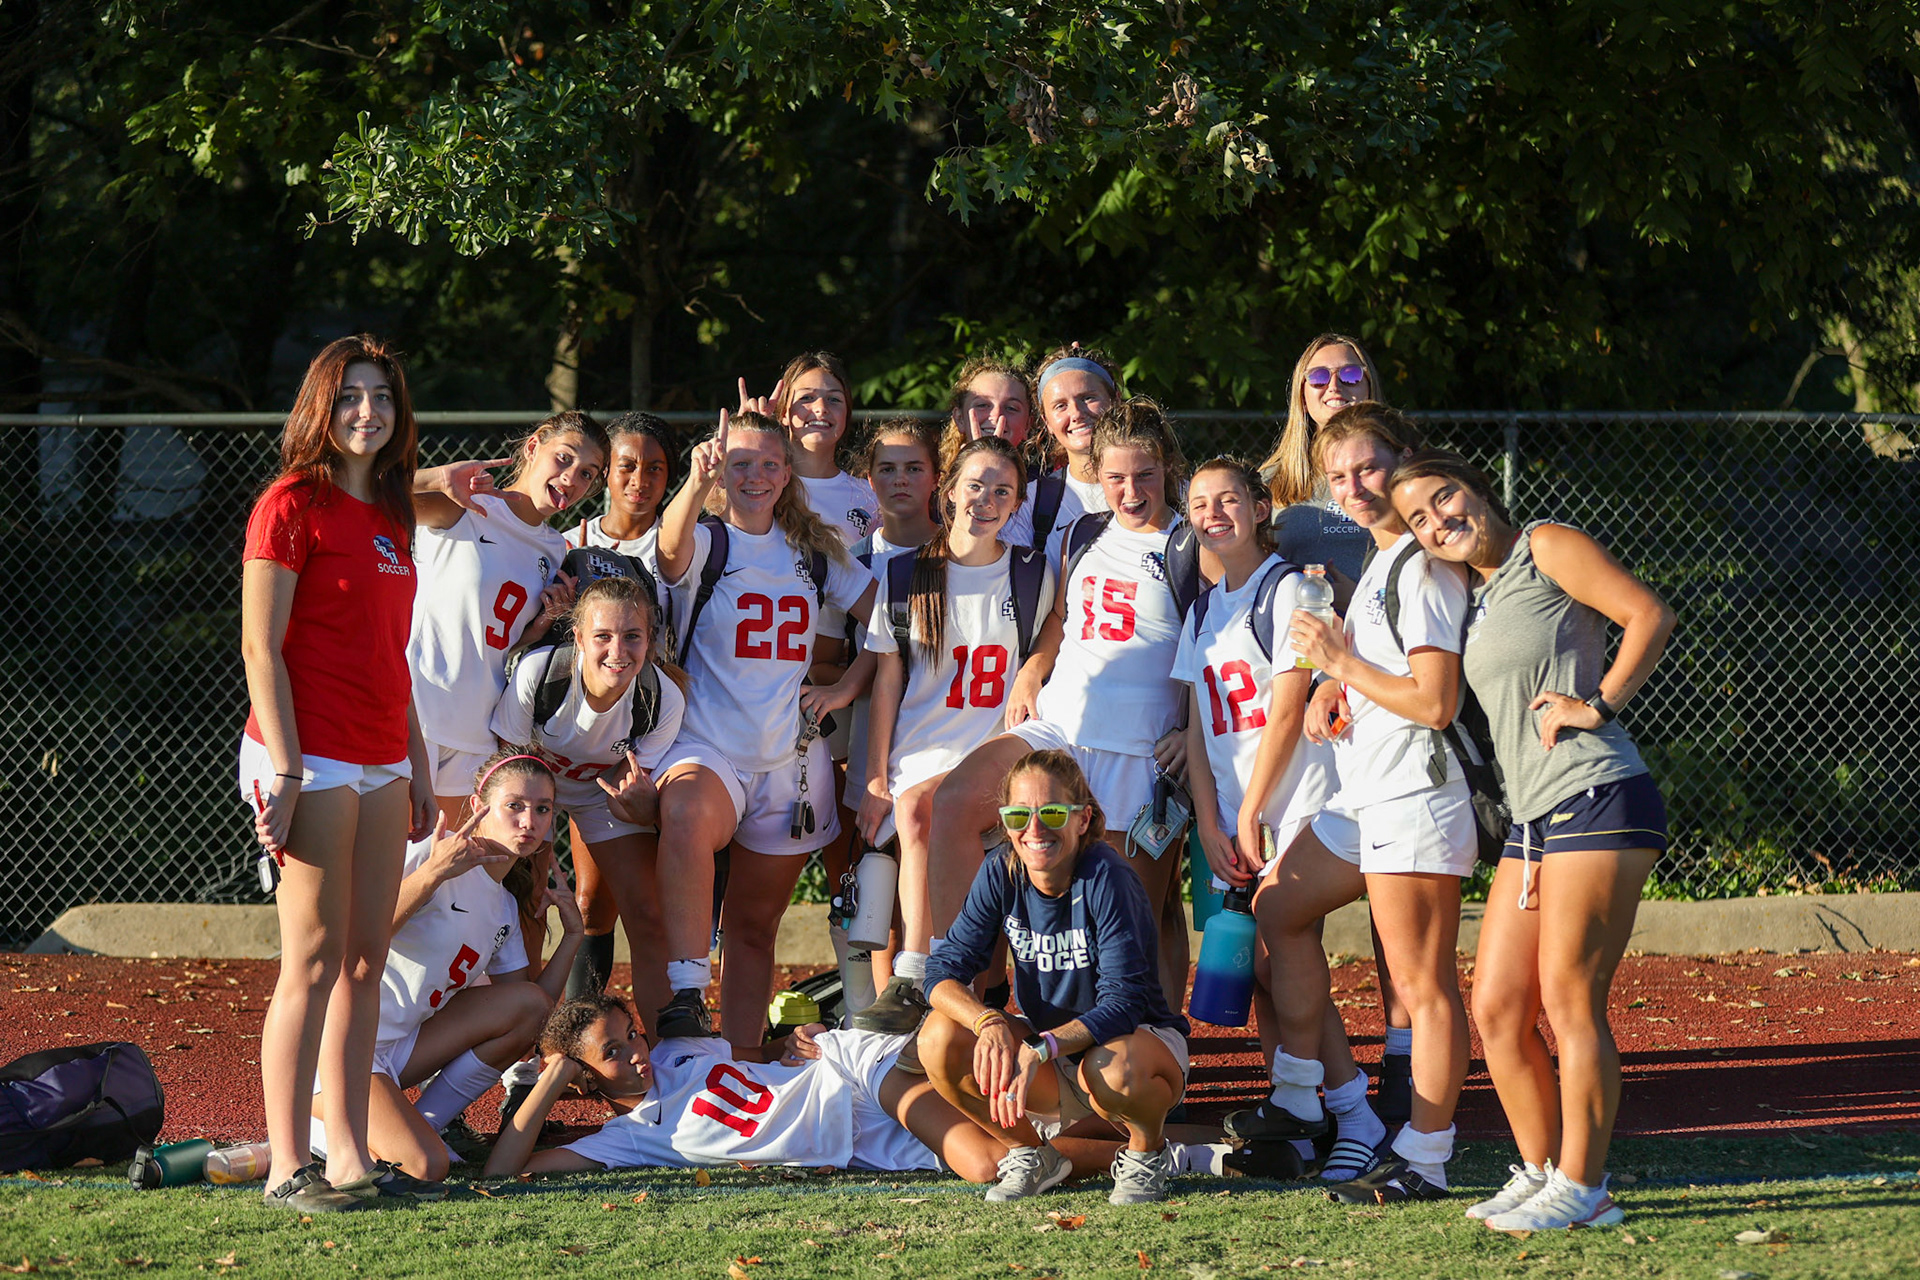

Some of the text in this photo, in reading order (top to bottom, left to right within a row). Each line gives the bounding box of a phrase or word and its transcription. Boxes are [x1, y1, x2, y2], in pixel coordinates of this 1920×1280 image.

[846, 509, 868, 537] SBA
[1323, 526, 1360, 534] SOCCER
[377, 562, 410, 576] SOCCER
[795, 562, 816, 591] SBA
[486, 580, 528, 650] 9
[735, 592, 810, 662] 22
[1081, 575, 1139, 642] 15
[946, 644, 1008, 709] 18
[1202, 659, 1267, 737] 12
[1003, 915, 1037, 962] SBA
[429, 943, 480, 1008] 5
[691, 1063, 774, 1137] 10
